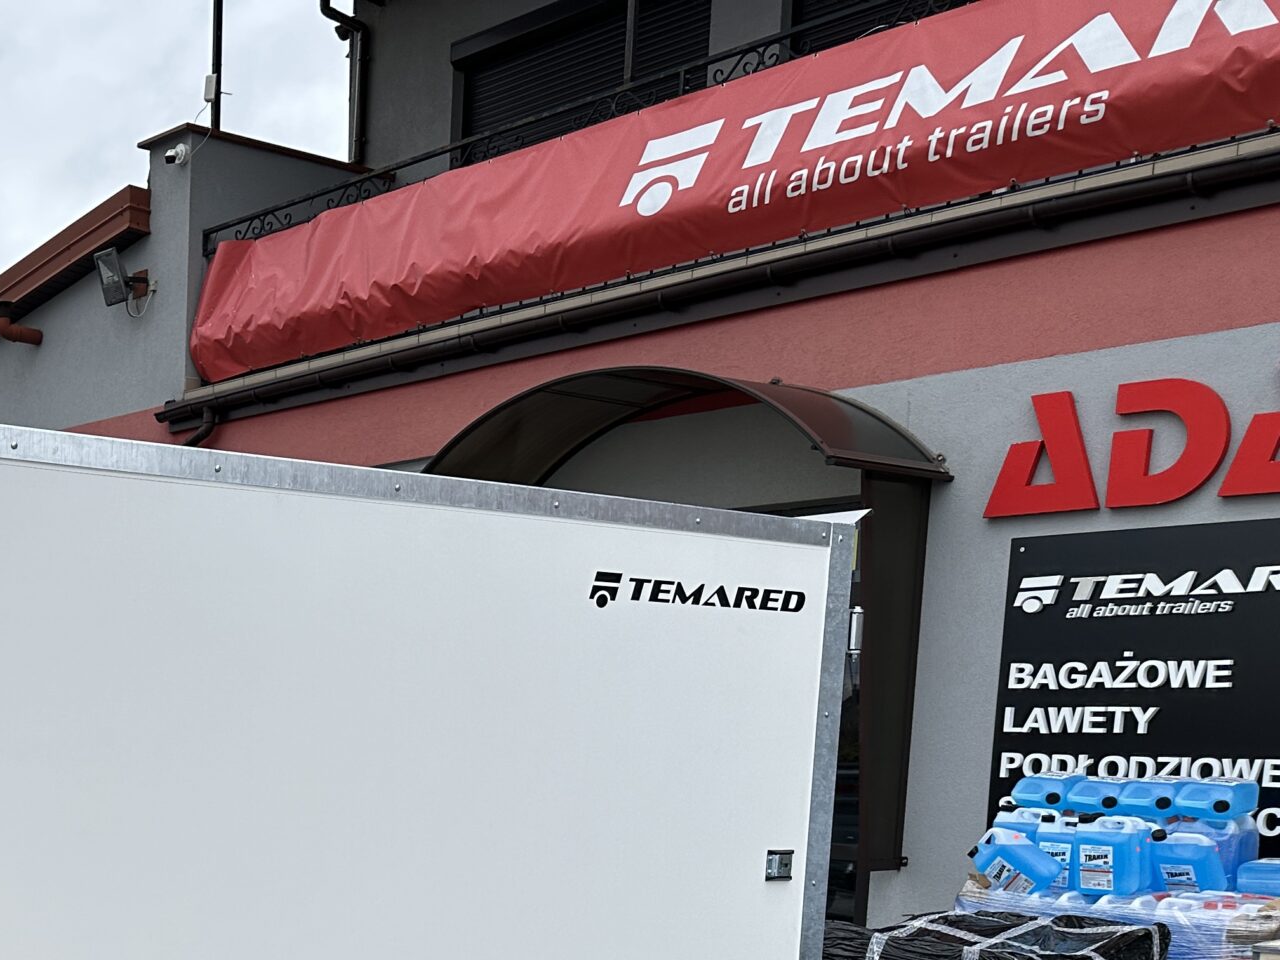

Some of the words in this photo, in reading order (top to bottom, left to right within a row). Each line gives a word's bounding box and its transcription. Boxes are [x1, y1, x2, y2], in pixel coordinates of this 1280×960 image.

[727, 168, 778, 214] all
[786, 135, 914, 198] about
[927, 89, 1110, 163] trailers
[628, 577, 806, 613] TEMARED
[1065, 603, 1092, 619] all
[1093, 601, 1152, 618] about
[1155, 598, 1235, 616] trailers
[1007, 651, 1234, 690] BAGAŻOWE
[1002, 707, 1160, 734] LAWETY
